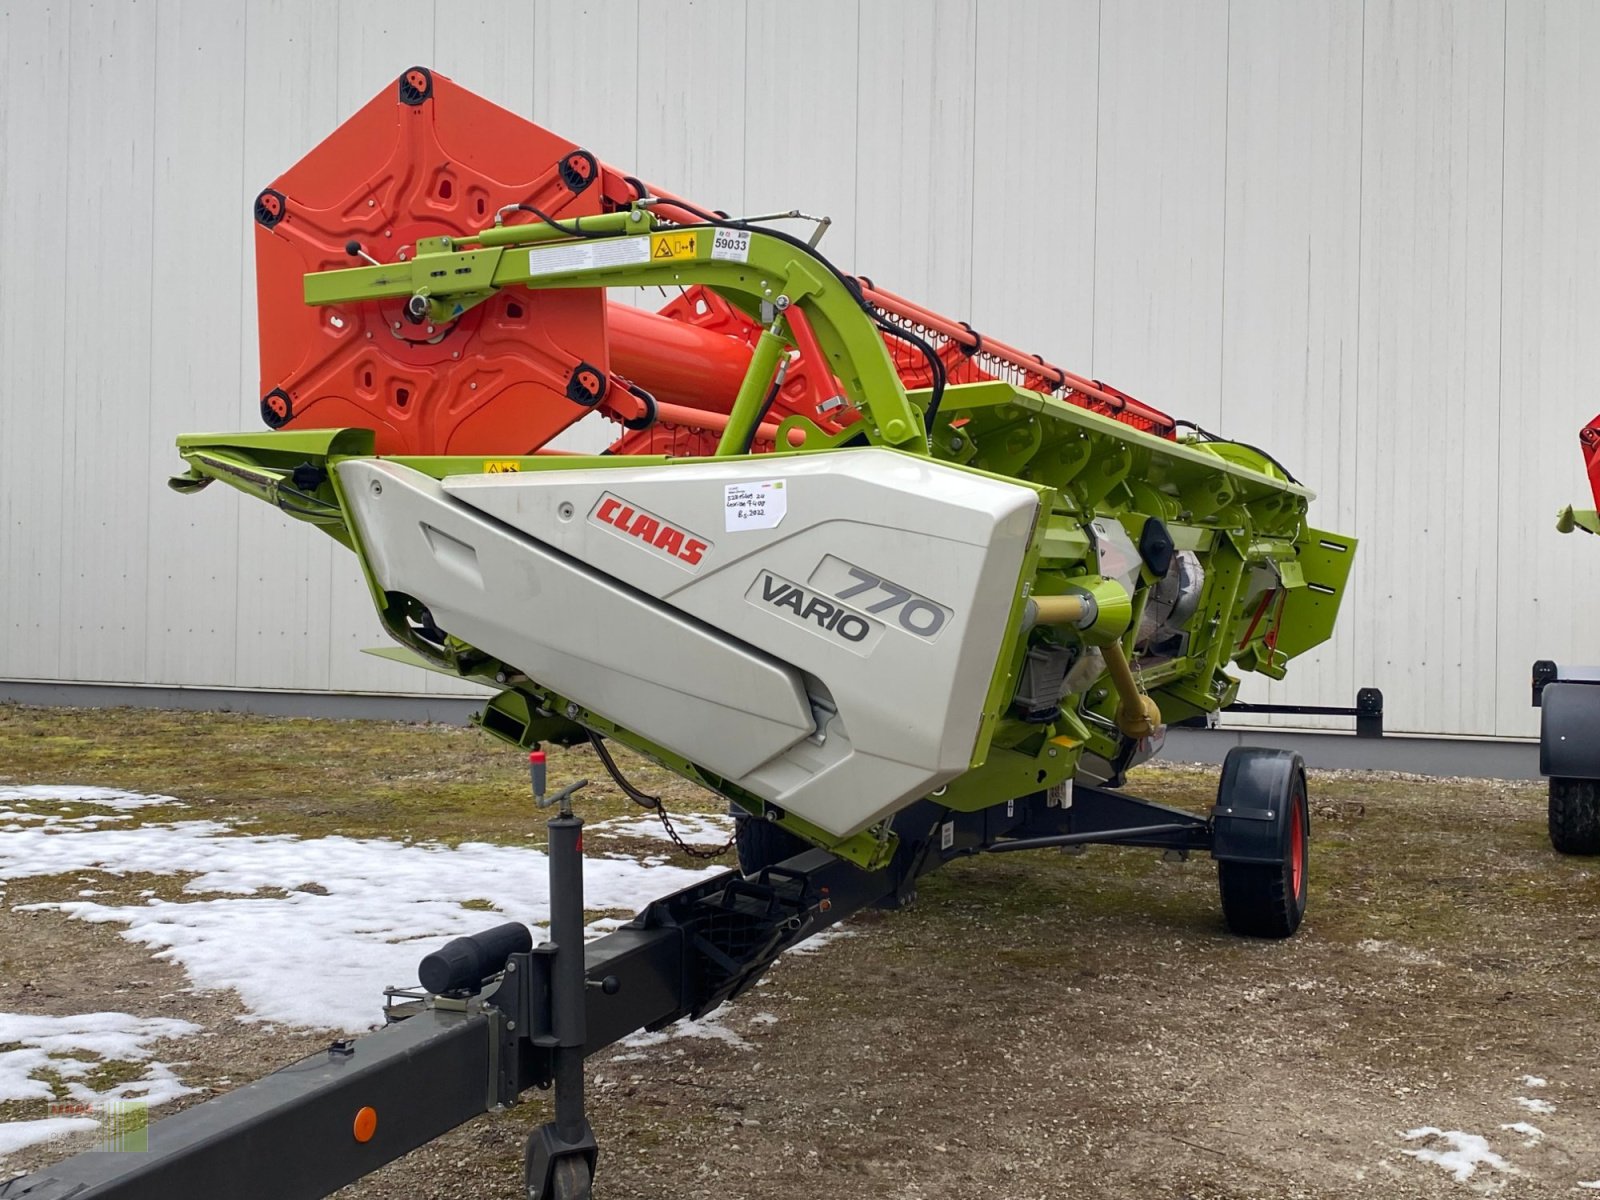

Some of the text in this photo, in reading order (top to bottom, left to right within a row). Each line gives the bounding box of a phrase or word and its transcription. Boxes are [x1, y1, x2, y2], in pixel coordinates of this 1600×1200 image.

[715, 238, 747, 251] 59033
[595, 498, 708, 566] CLAAS
[761, 575, 871, 643] VARIO
[834, 567, 945, 637] 770
